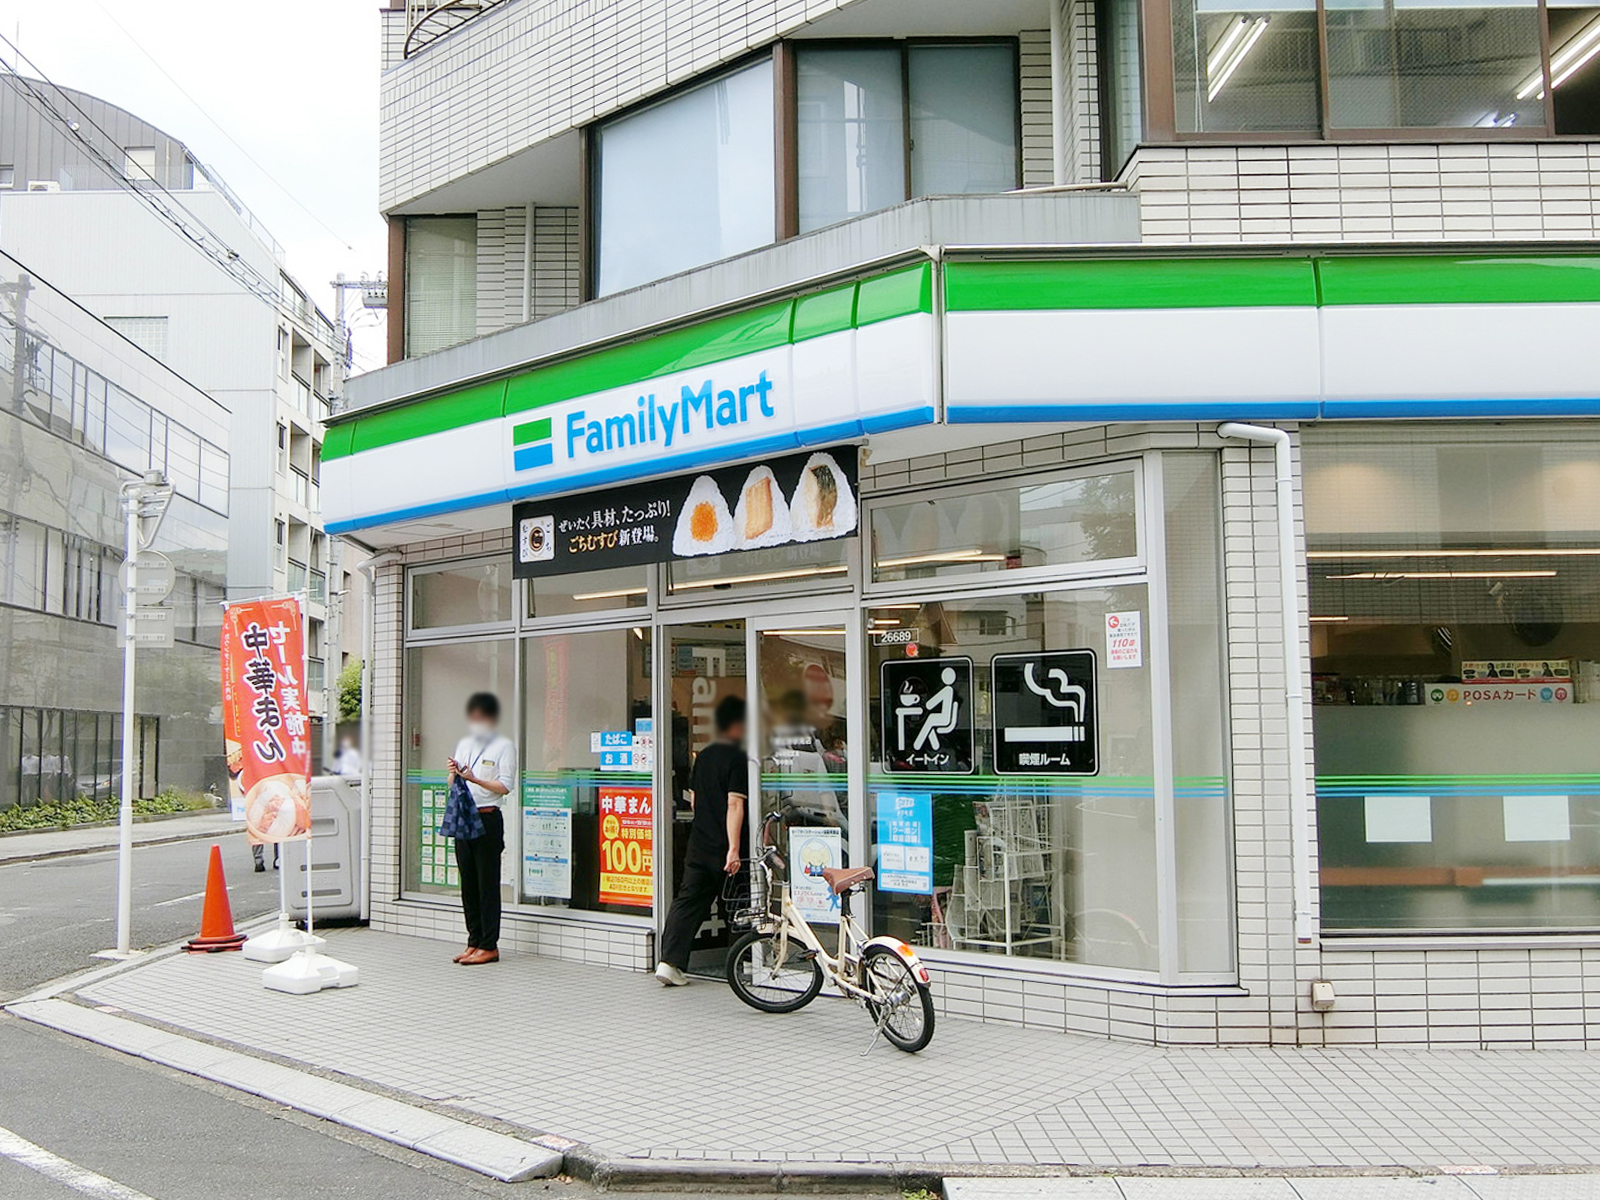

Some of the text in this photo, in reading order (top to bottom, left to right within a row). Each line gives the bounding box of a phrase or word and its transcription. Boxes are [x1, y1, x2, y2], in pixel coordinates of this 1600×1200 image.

[567, 370, 775, 459] FamilyMart
[881, 631, 911, 643] 26689
[1463, 689, 1537, 701] POSAカード
[605, 733, 627, 745] たばこ
[906, 753, 949, 766] イートイン
[1018, 753, 1071, 766] 喫煙ルーム
[602, 795, 651, 814] 中華まん
